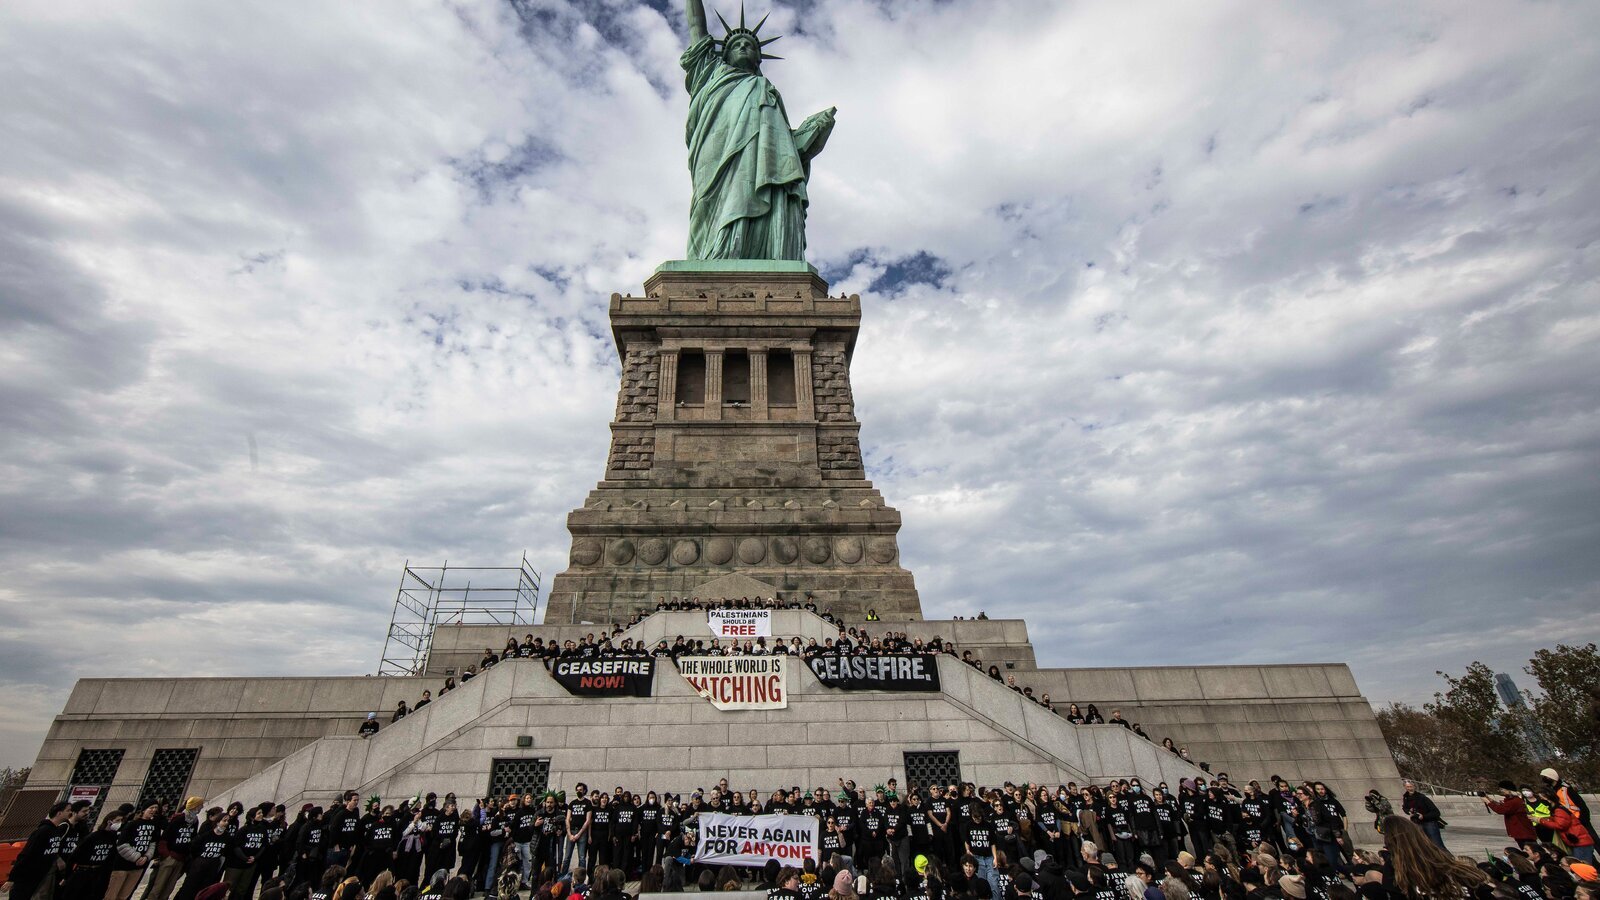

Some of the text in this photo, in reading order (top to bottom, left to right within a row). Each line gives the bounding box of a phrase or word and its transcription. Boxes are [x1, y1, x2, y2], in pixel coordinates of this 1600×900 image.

[722, 625, 756, 635] FREE
[558, 661, 650, 675] CEASEFIRE
[681, 659, 780, 674] THE WHOLE WORLD IS
[811, 656, 931, 681] CEASEFIRE.
[580, 676, 625, 689] NOW!
[706, 825, 811, 843] NEVER AGAIN
[704, 840, 812, 859] FOR ANYONE
